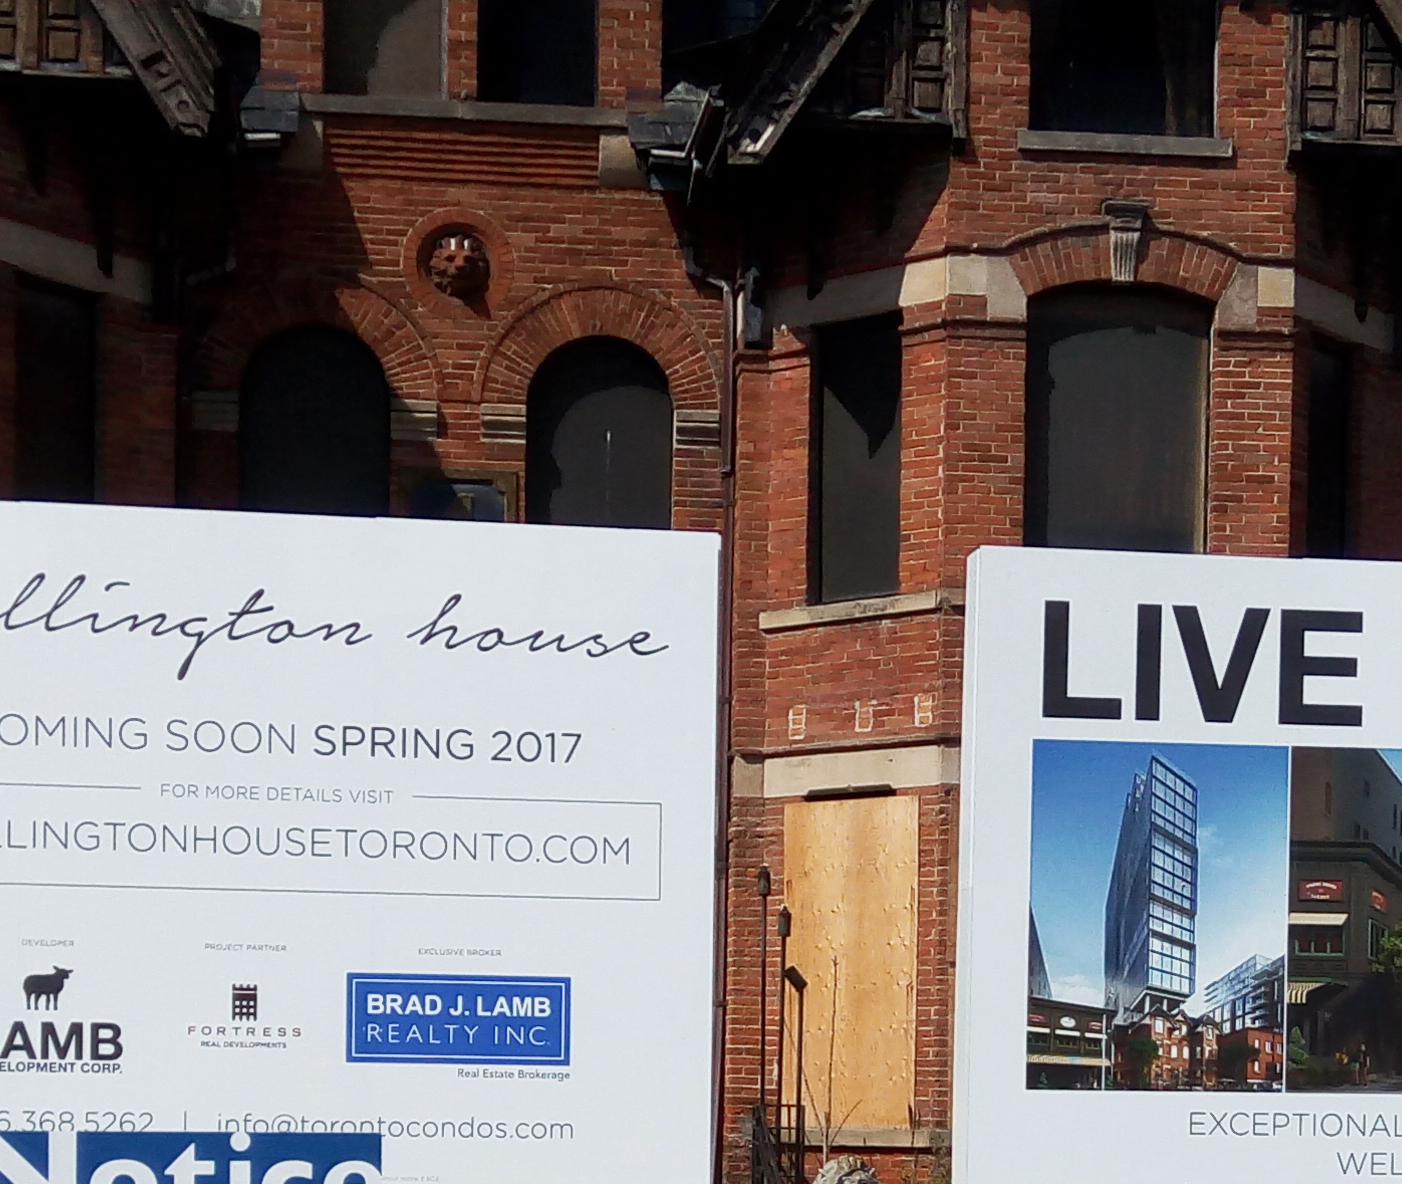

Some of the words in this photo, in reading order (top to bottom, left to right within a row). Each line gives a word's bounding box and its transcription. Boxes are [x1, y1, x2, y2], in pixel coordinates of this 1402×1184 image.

[406, 593, 670, 658] house
[1041, 599, 1364, 728] LIVE
[165, 718, 295, 755] SOON
[313, 724, 474, 761] SPRING
[490, 730, 582, 764] 2017
[160, 783, 199, 799] FOR
[205, 784, 260, 801] MORE
[266, 786, 343, 803] DETAILS
[348, 789, 394, 805] VISIT
[21, 938, 75, 947] DEVELOPER
[204, 942, 244, 952] PROJECT
[246, 943, 287, 952] PARTNER
[418, 947, 465, 957] EXCLUSIVE
[466, 948, 502, 957] BROKER
[367, 993, 443, 1016] BRAD
[448, 995, 470, 1016] J.
[476, 995, 552, 1018] LAMB
[187, 1025, 302, 1038] FORTRESS
[367, 1023, 479, 1044] REALTY
[200, 1040, 222, 1048] REAL
[223, 1040, 287, 1049] DEVELOPMENTS
[80, 1062, 123, 1074] CORP.
[457, 1067, 480, 1078] Real
[482, 1068, 515, 1079] Estate
[517, 1068, 571, 1083] Brokerage
